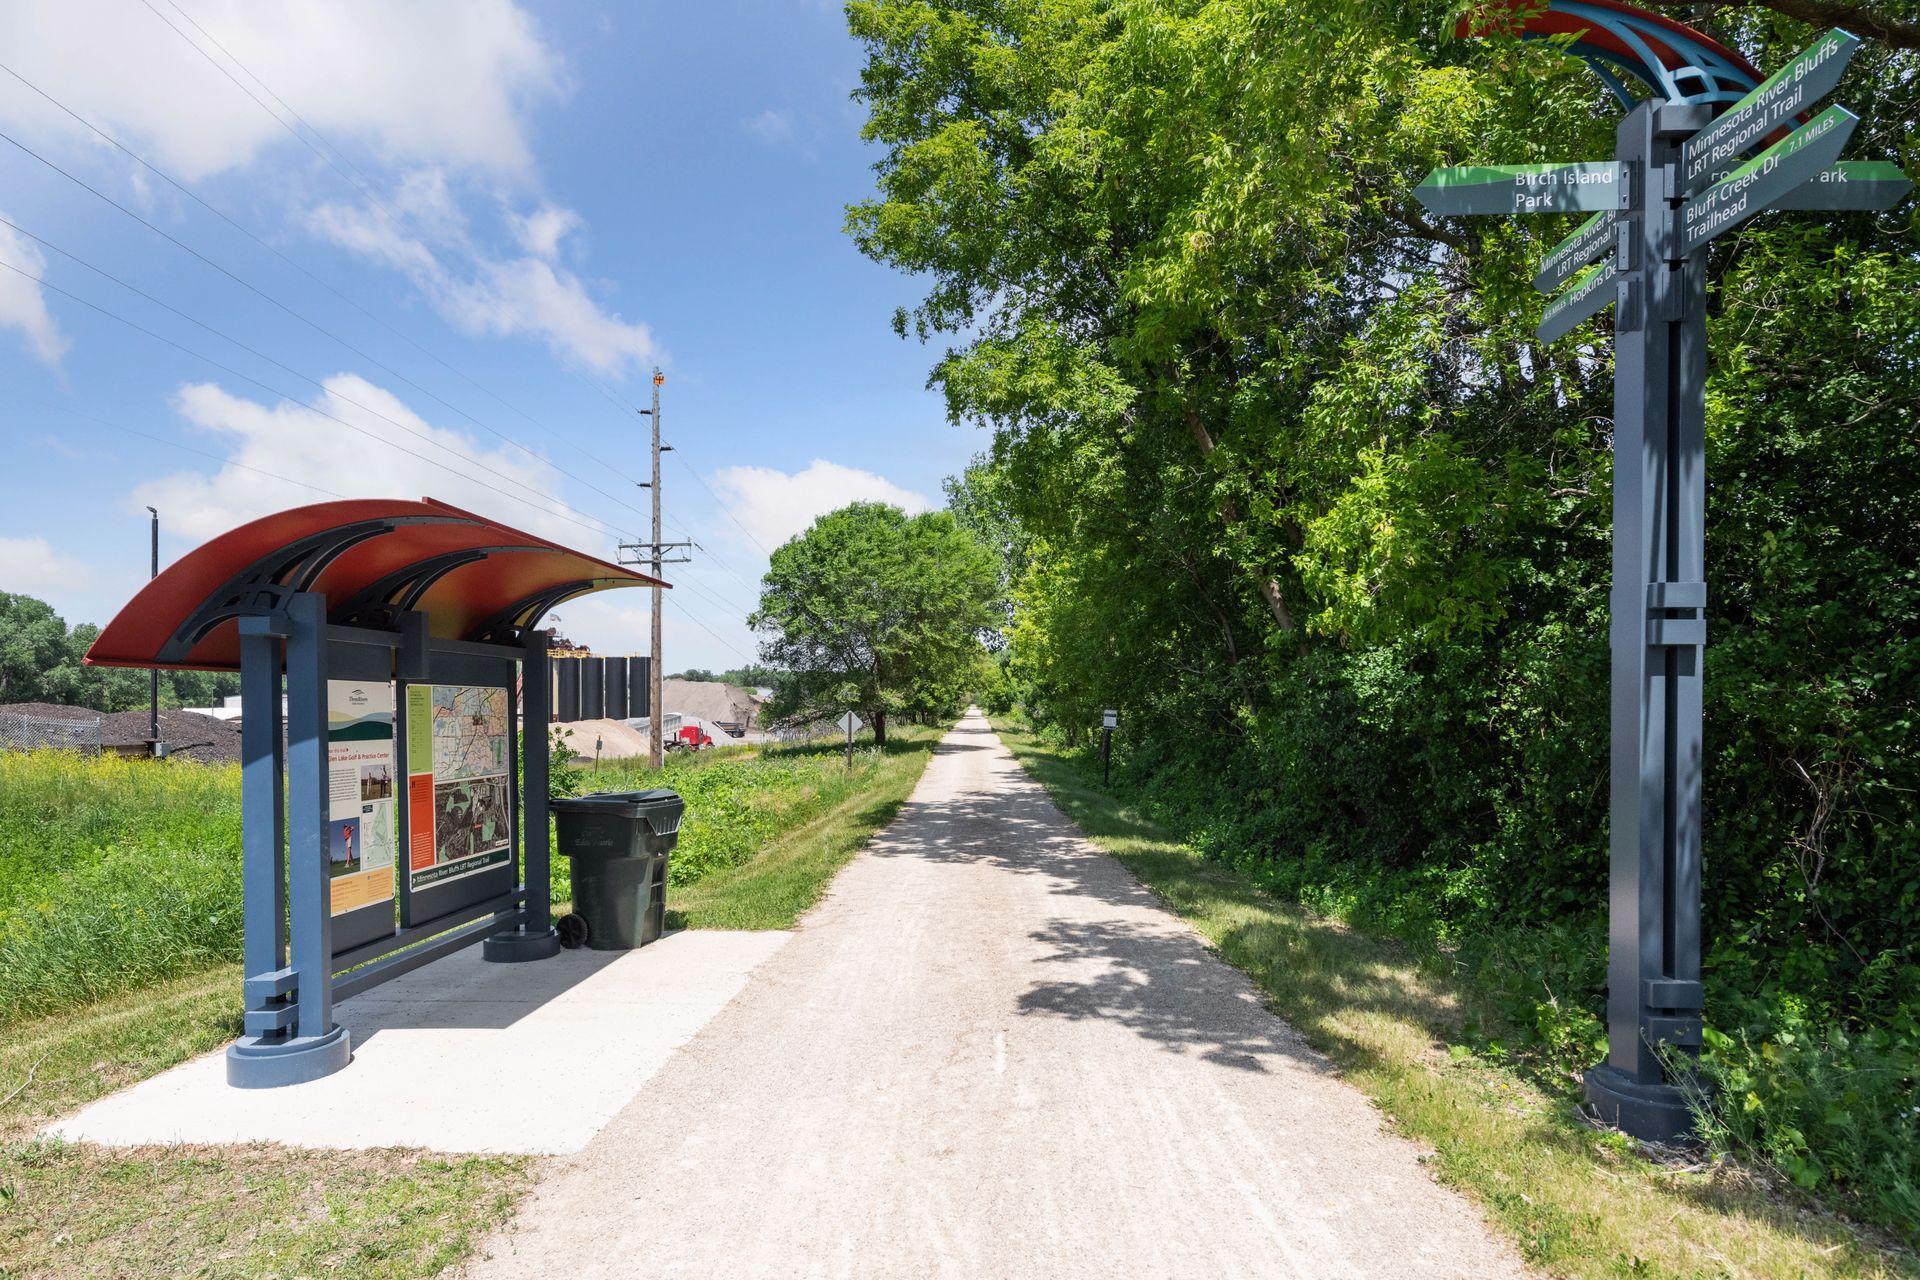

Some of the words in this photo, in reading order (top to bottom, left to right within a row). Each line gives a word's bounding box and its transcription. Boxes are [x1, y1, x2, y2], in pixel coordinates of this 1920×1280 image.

[1688, 103, 1753, 161] Minnesota
[1756, 77, 1791, 111] River
[1794, 38, 1838, 82] Bluffs
[1688, 153, 1708, 180] LRT
[1711, 111, 1768, 164] Regional
[1771, 85, 1803, 120] Trail
[1515, 171, 1557, 186] Birch
[1563, 168, 1612, 185] Island
[1686, 189, 1718, 224] Bluff
[1720, 168, 1760, 201] Creek
[1763, 153, 1781, 176] Dr
[1789, 137, 1803, 153] 7.1
[1805, 116, 1835, 141] MILES
[1810, 168, 1848, 183] ark
[1515, 192, 1553, 208] Park
[1686, 192, 1747, 243] Trailhead
[1540, 235, 1582, 275] Minnesota
[1583, 216, 1605, 241] River
[1557, 259, 1572, 277] LRT
[1573, 226, 1611, 265] Regional
[1569, 275, 1604, 307] Hopkins
